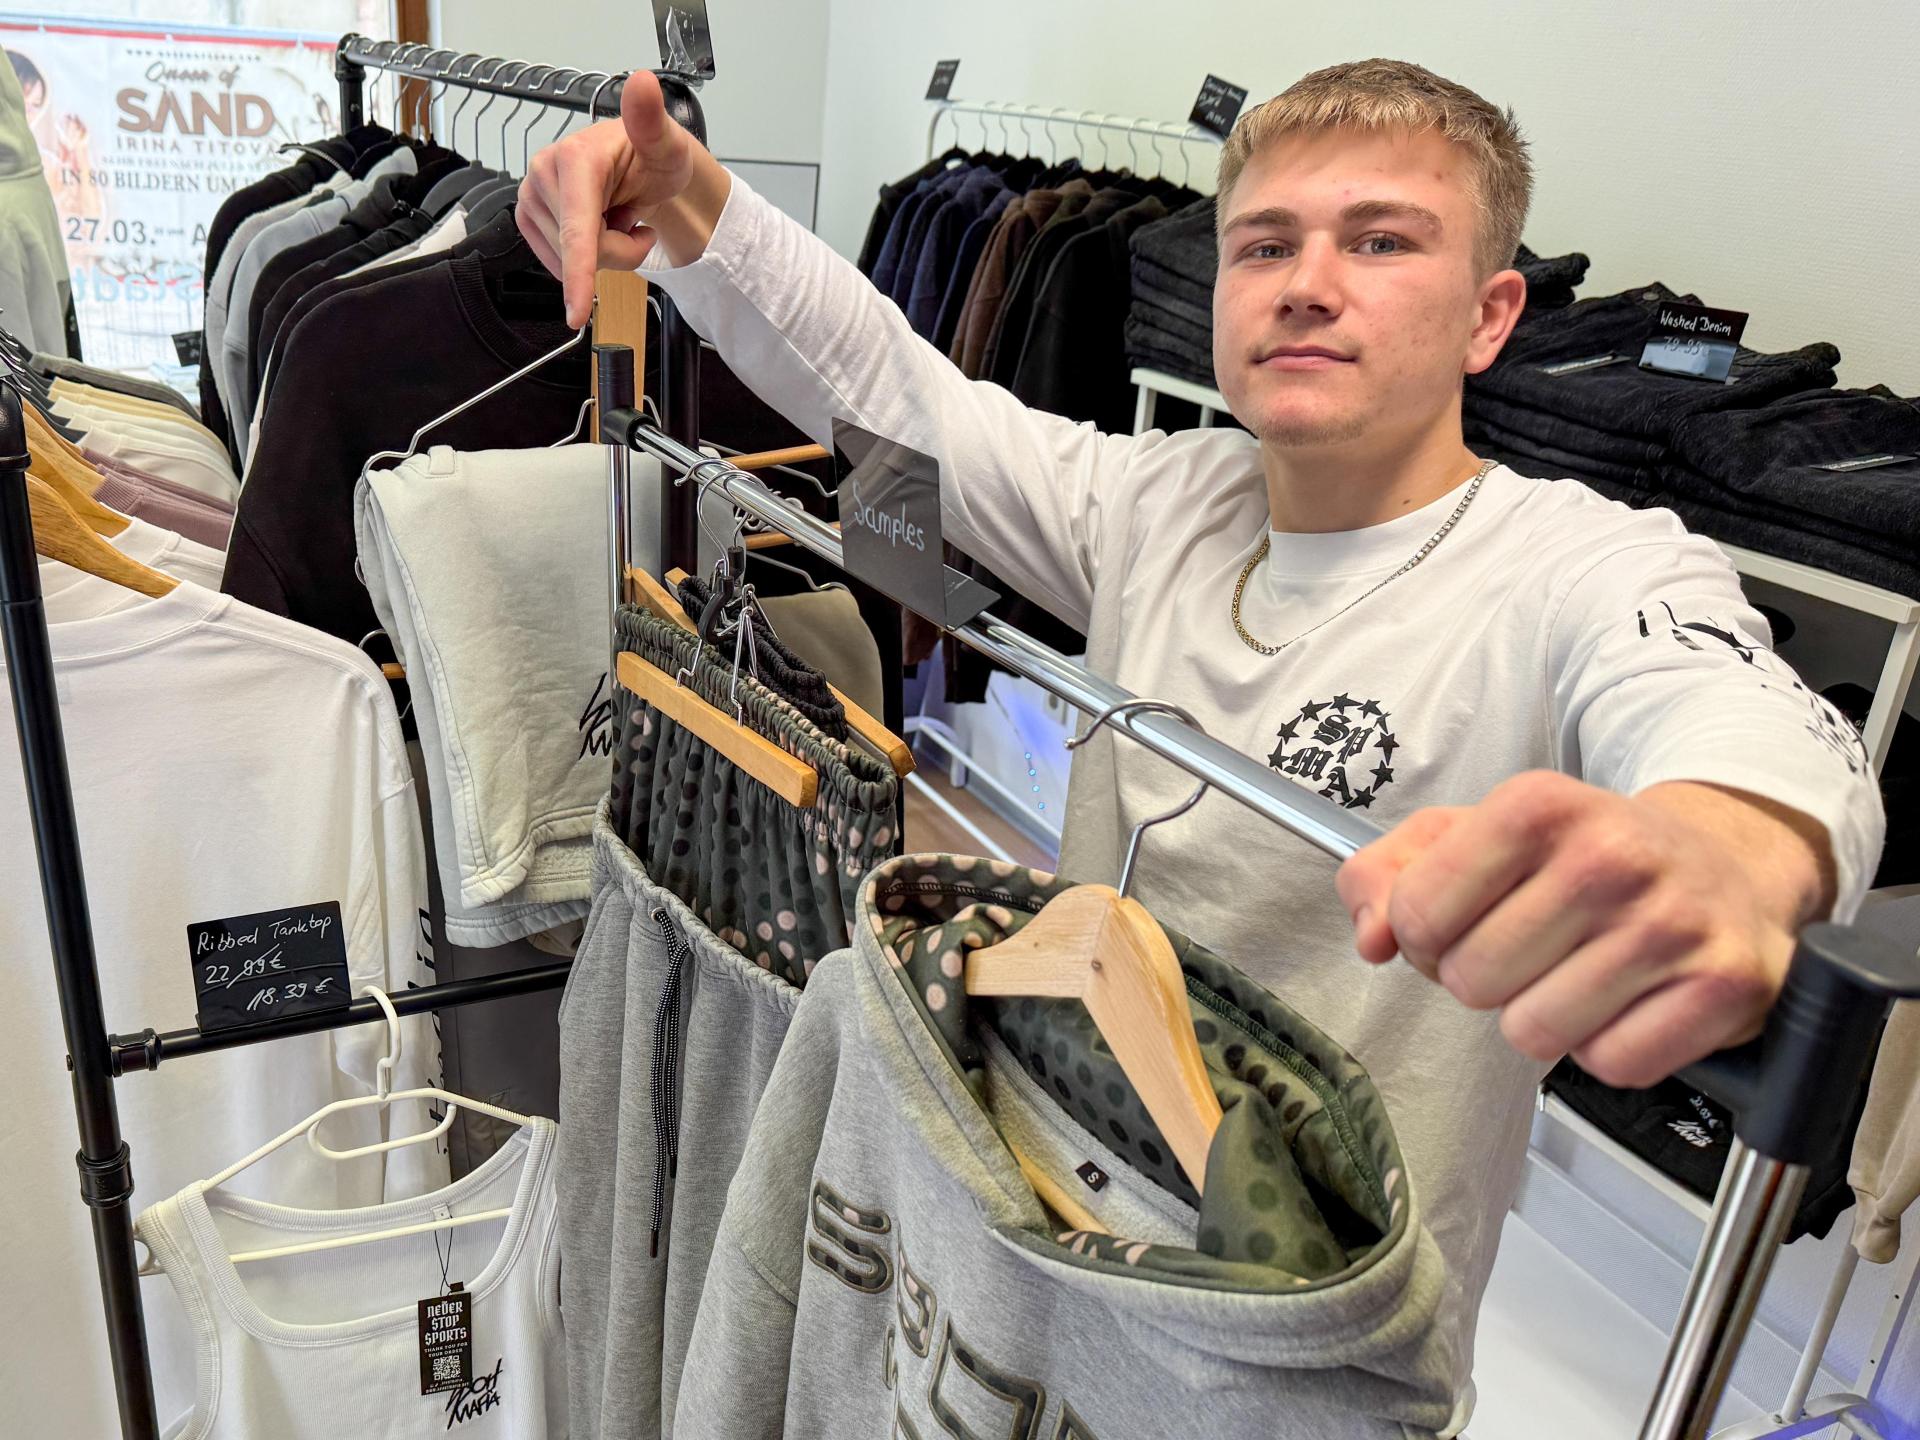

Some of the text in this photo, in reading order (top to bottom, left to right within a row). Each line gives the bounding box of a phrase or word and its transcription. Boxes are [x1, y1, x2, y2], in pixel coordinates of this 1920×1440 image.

[116, 88, 275, 137] SAND
[117, 137, 279, 157] IRINA TITOVA
[61, 169, 81, 185] IN
[88, 170, 109, 188] 80
[115, 172, 201, 194] BILDERN
[66, 217, 156, 246] 27.03.
[1660, 310, 1732, 337] Washed Denim
[852, 478, 925, 552] Samples
[196, 928, 259, 955] Ribbed
[1087, 1171, 1099, 1184] S
[431, 1314, 460, 1331] STOP
[424, 1327, 467, 1346] SPORTS
[424, 1346, 444, 1354] THANK
